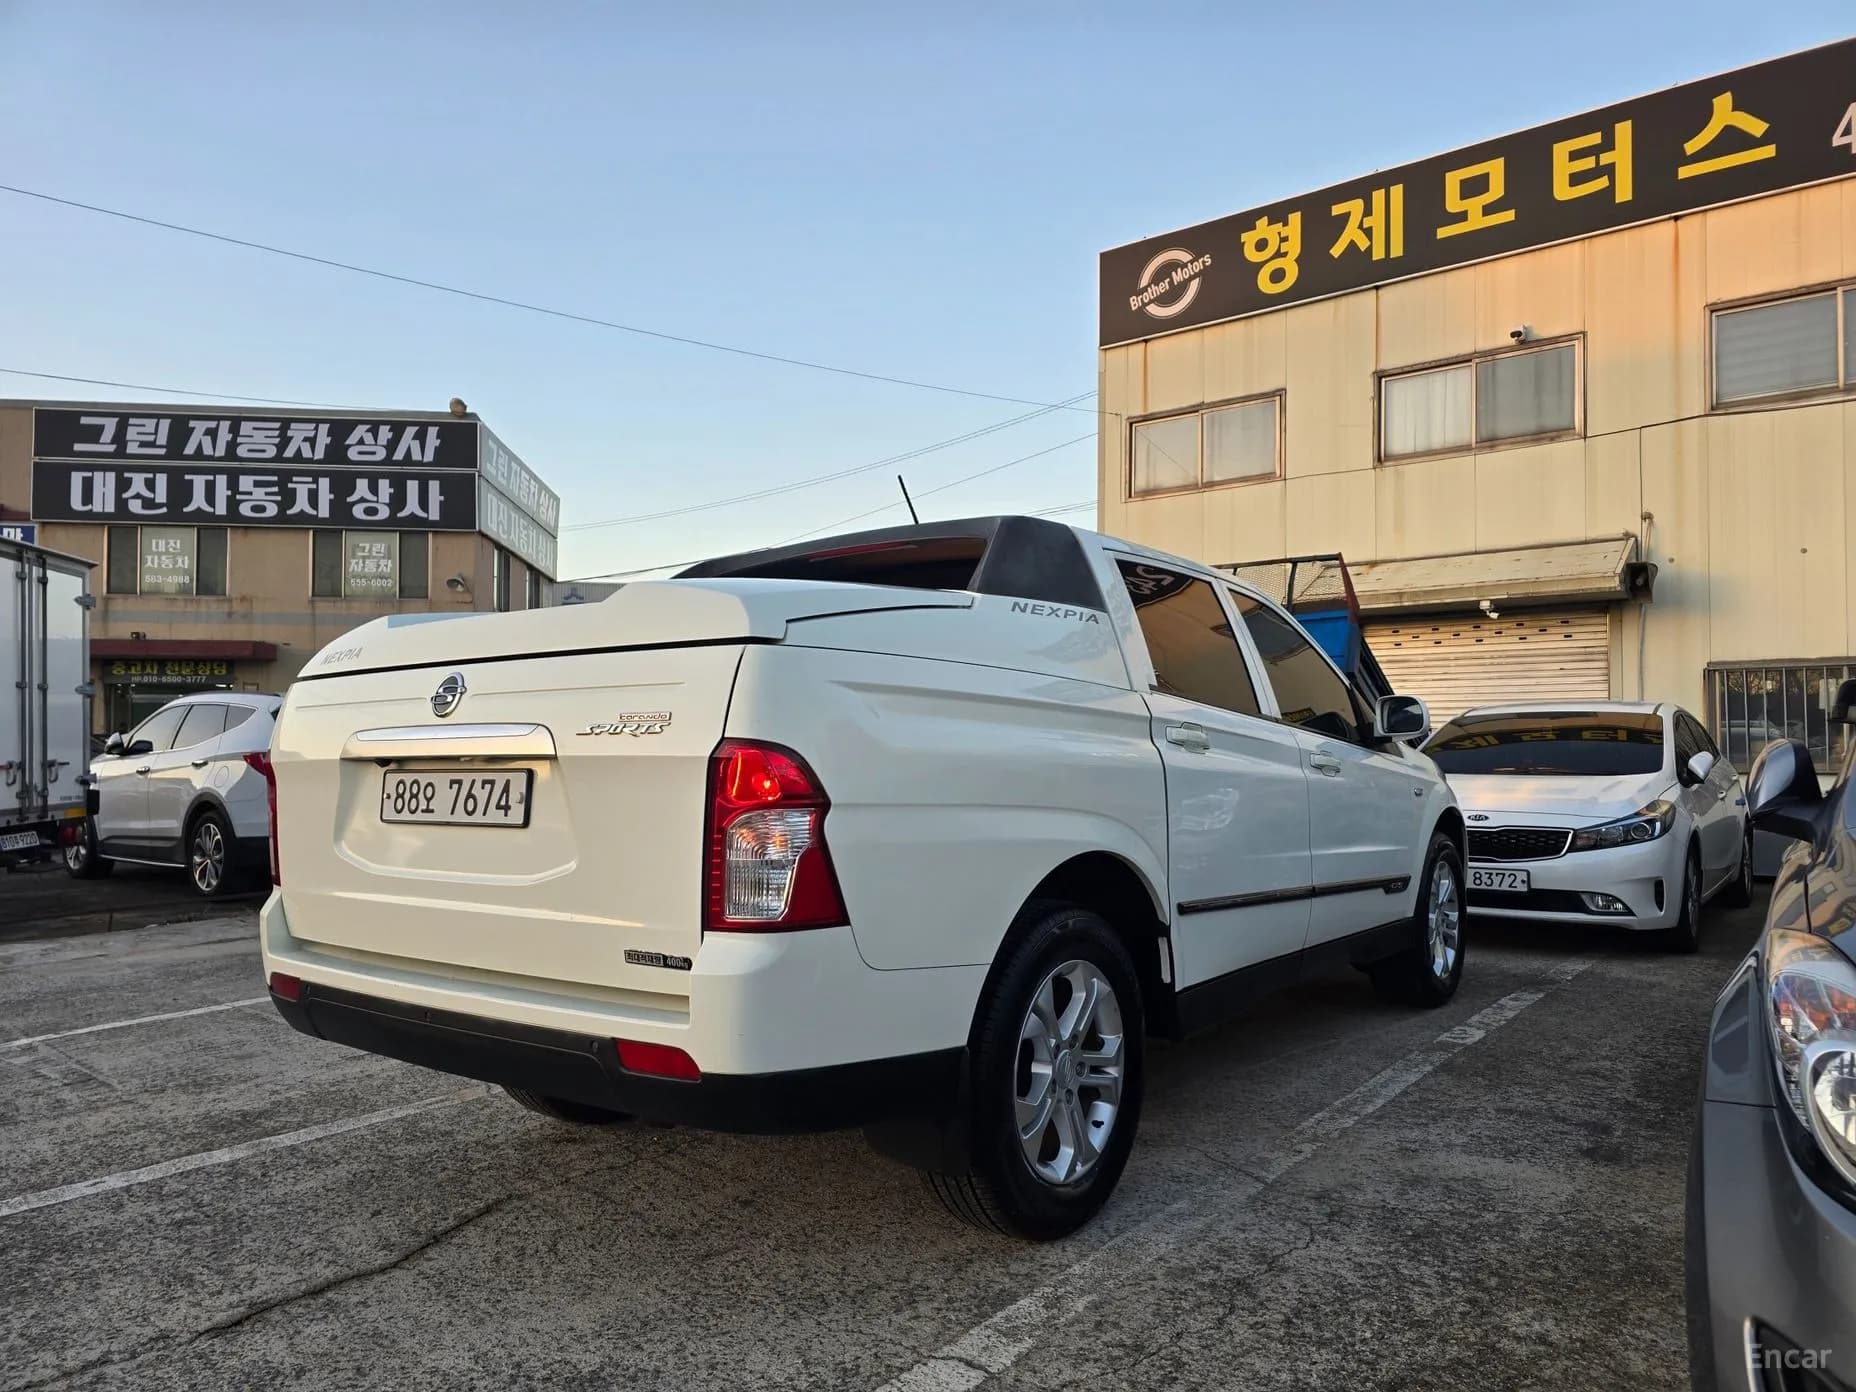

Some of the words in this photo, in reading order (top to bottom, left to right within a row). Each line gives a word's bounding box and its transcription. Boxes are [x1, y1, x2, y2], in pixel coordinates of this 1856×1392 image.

[1241, 91, 1776, 294] 형제모터스
[1129, 278, 1170, 311] Brother
[1171, 254, 1212, 286] Motors
[73, 416, 170, 455] 그린
[183, 418, 331, 460] 자동차
[344, 424, 441, 463] 상사
[487, 439, 508, 487] 그린
[510, 461, 539, 512] 자동차
[69, 471, 169, 515] 대진
[183, 474, 335, 519] 자동차
[346, 477, 444, 521] 상사
[151, 538, 181, 553] 대진
[357, 543, 385, 556] 그린
[144, 554, 189, 569] 자동차
[349, 559, 393, 573] 자동차
[1010, 601, 1100, 625] NEXPIA
[320, 646, 363, 666] NEXPIA
[576, 722, 671, 738] SPORTS
[393, 778, 436, 815] 88오
[448, 778, 512, 817] 7674
[1472, 871, 1518, 889] 8372
